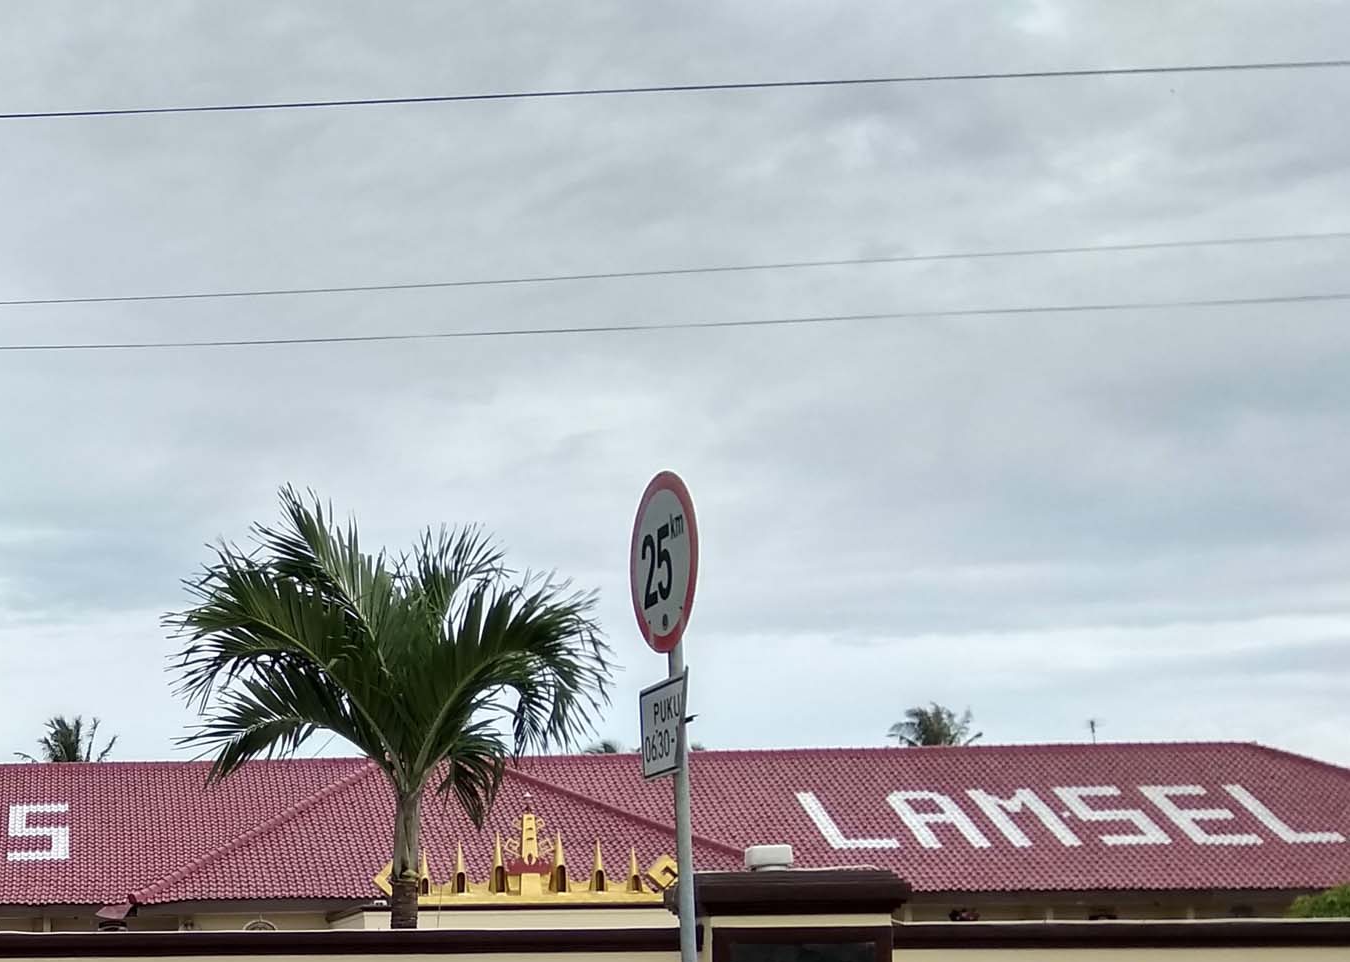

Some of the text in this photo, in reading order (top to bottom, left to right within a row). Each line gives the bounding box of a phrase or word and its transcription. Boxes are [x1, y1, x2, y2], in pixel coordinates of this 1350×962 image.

[641, 513, 684, 610] 25 km
[795, 784, 1347, 849] LAMSEL
